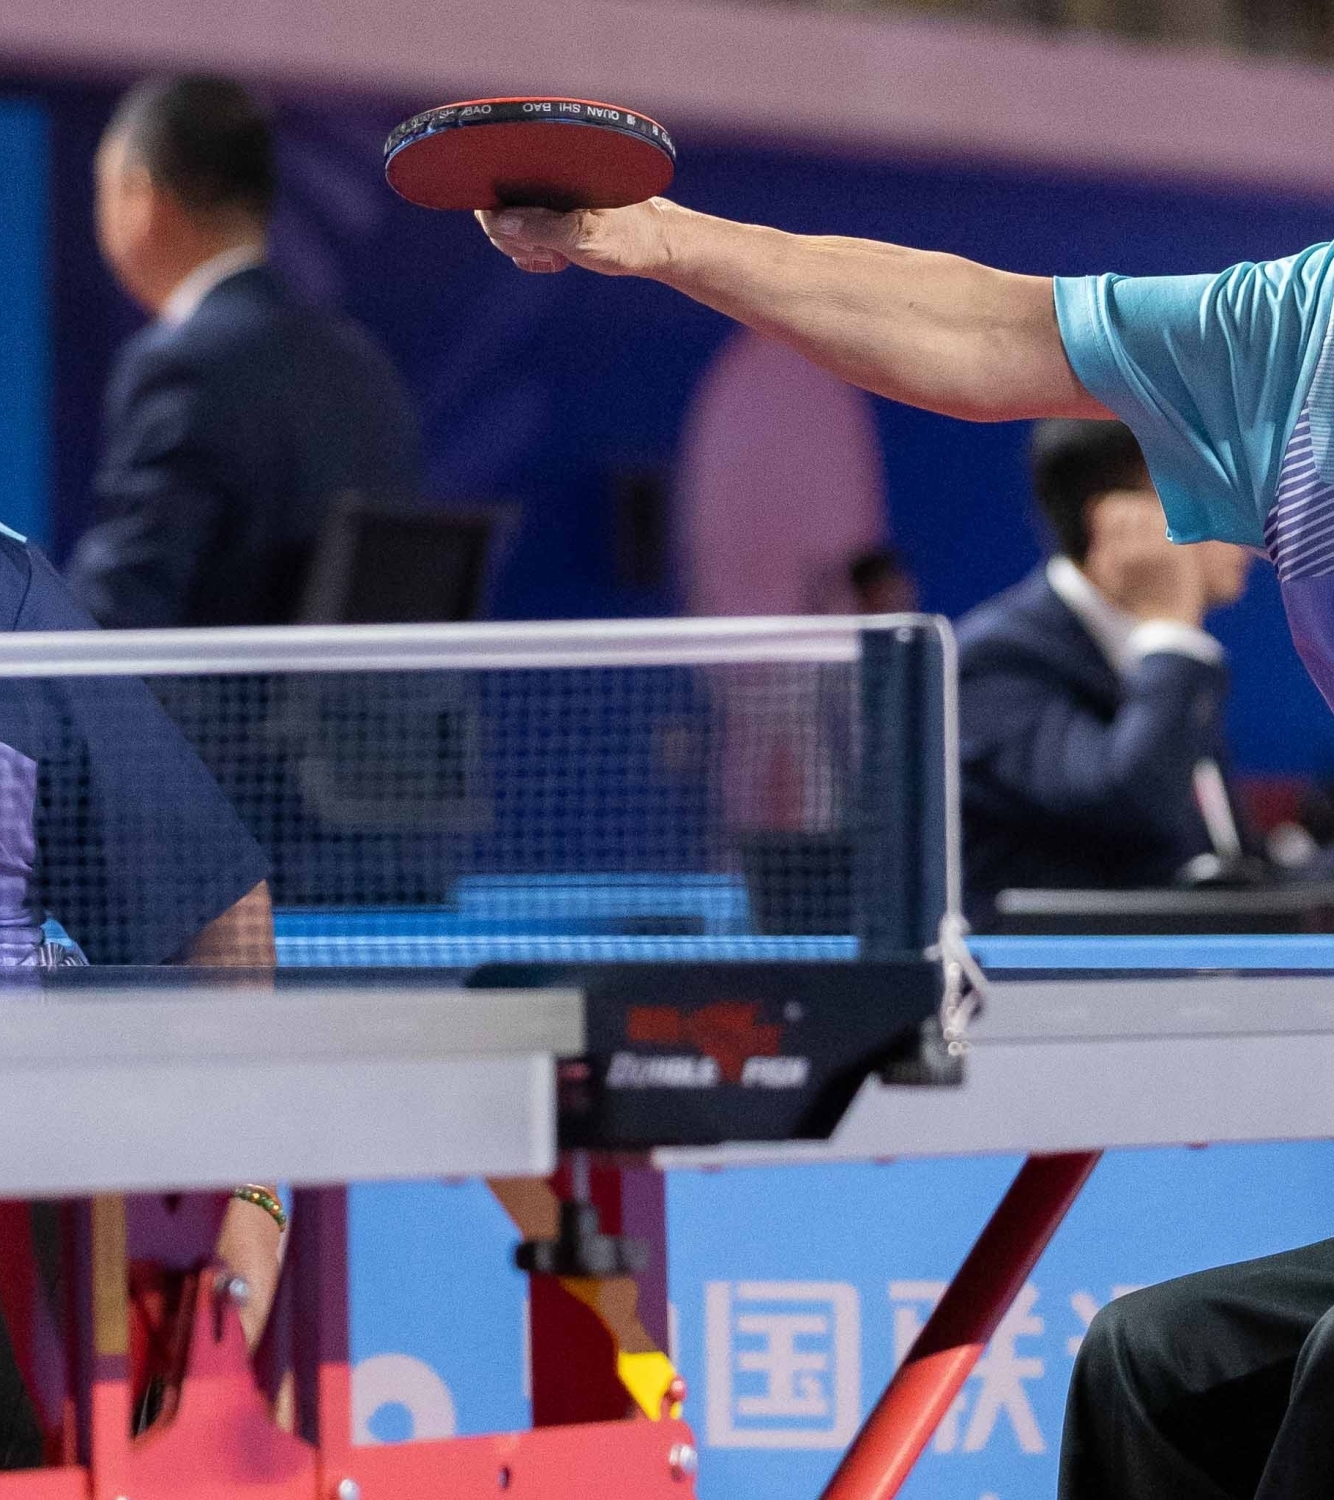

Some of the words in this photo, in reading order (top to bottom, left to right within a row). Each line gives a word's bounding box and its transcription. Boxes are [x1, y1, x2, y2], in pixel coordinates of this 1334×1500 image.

[522, 102, 552, 113] BAO
[559, 103, 582, 114] SHI
[587, 105, 620, 121] QUAN
